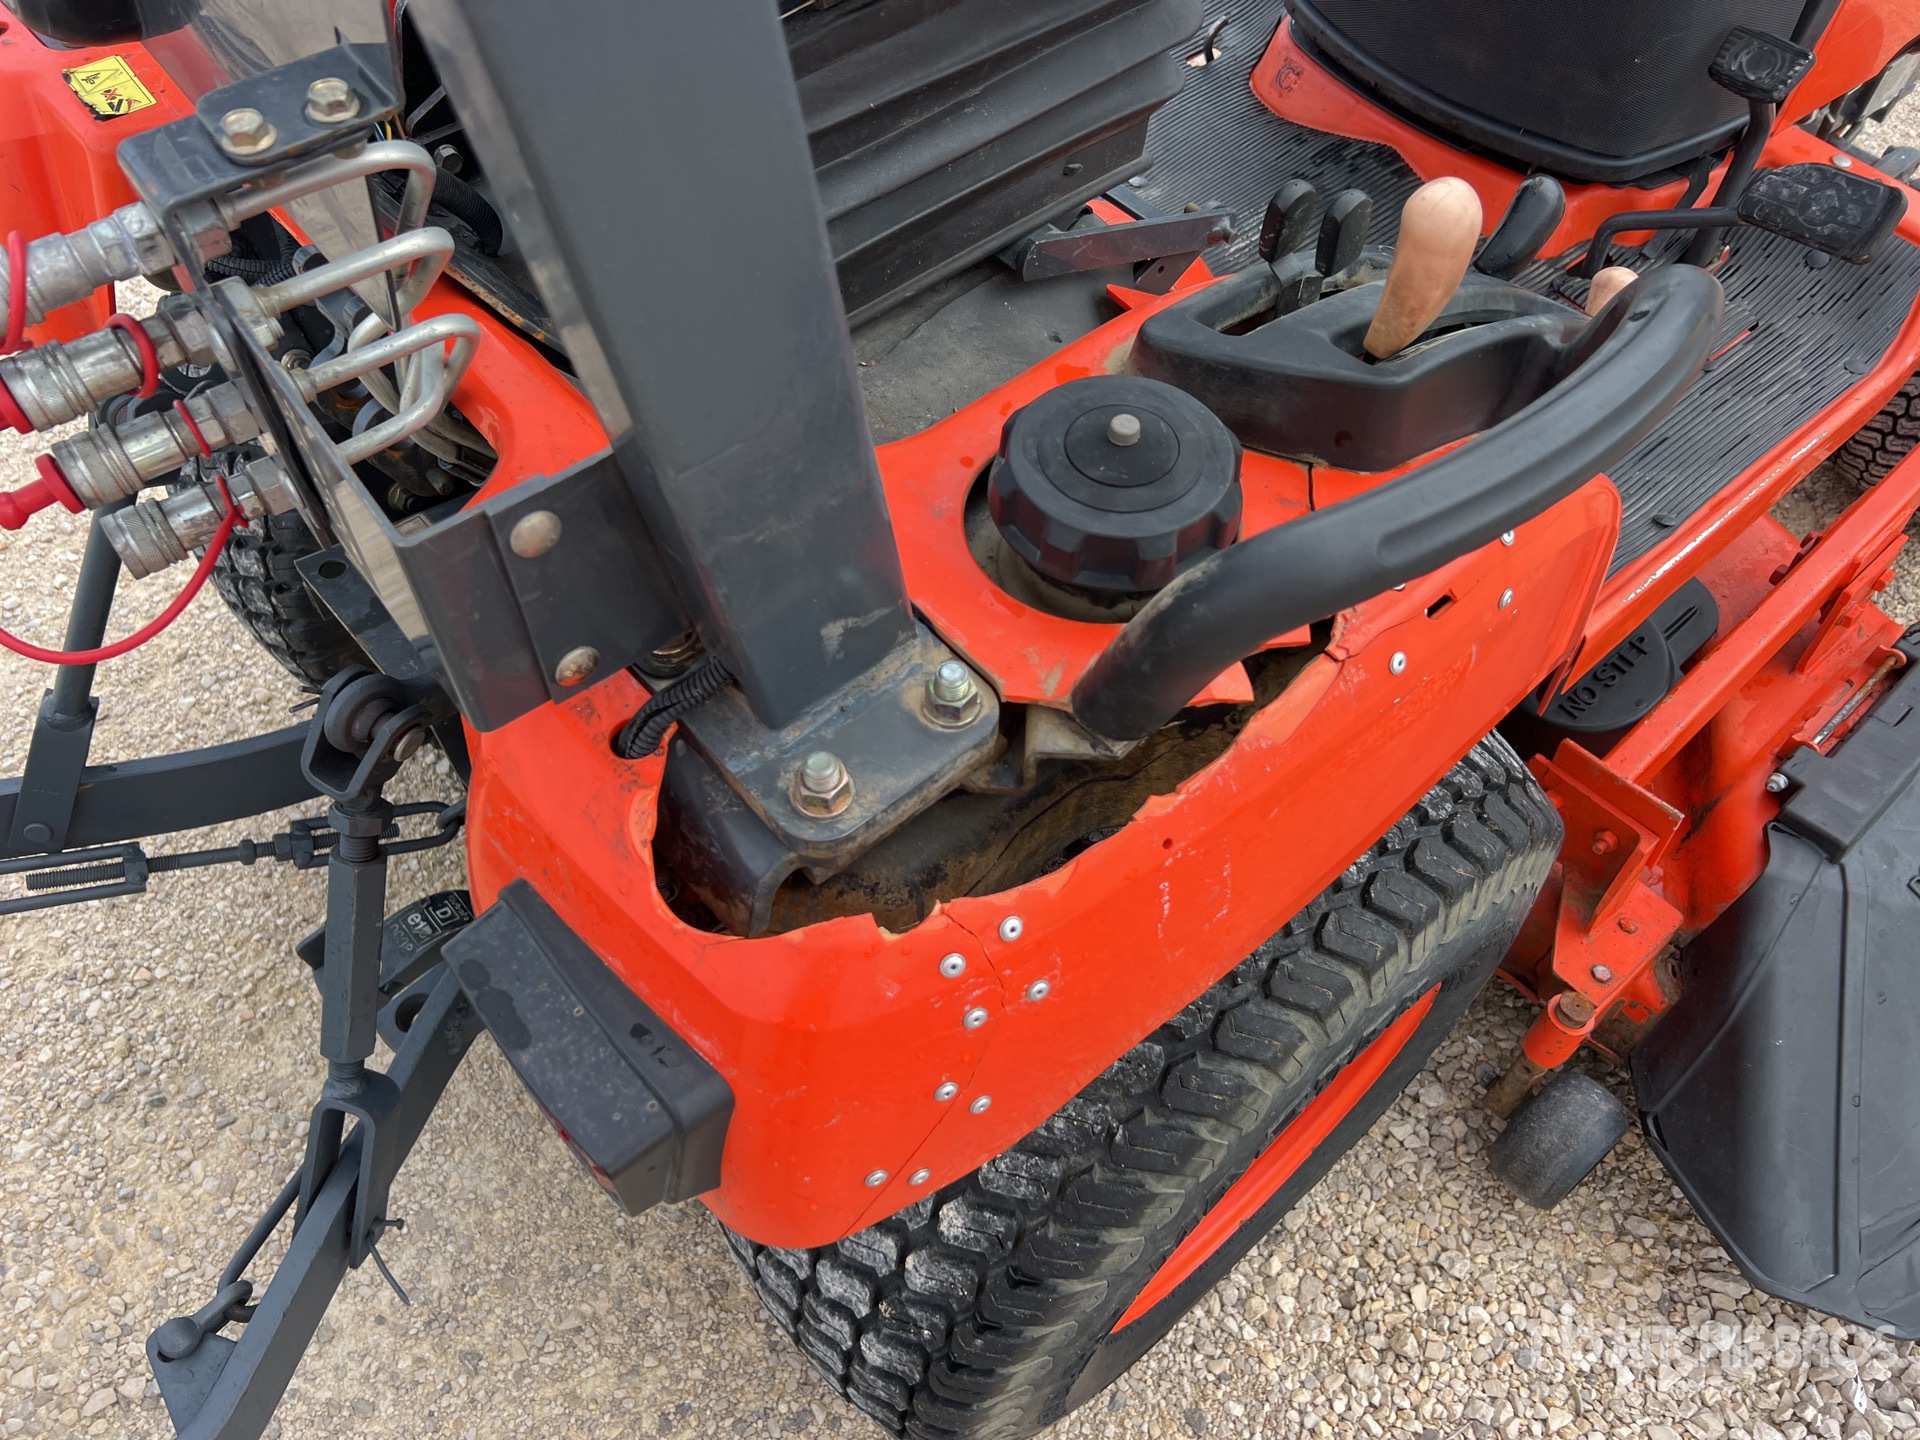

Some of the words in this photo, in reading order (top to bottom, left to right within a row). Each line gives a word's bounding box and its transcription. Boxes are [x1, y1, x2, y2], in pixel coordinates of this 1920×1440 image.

[1557, 686, 1598, 721] NO
[1593, 635, 1649, 688] STEP
[436, 906, 452, 919] D
